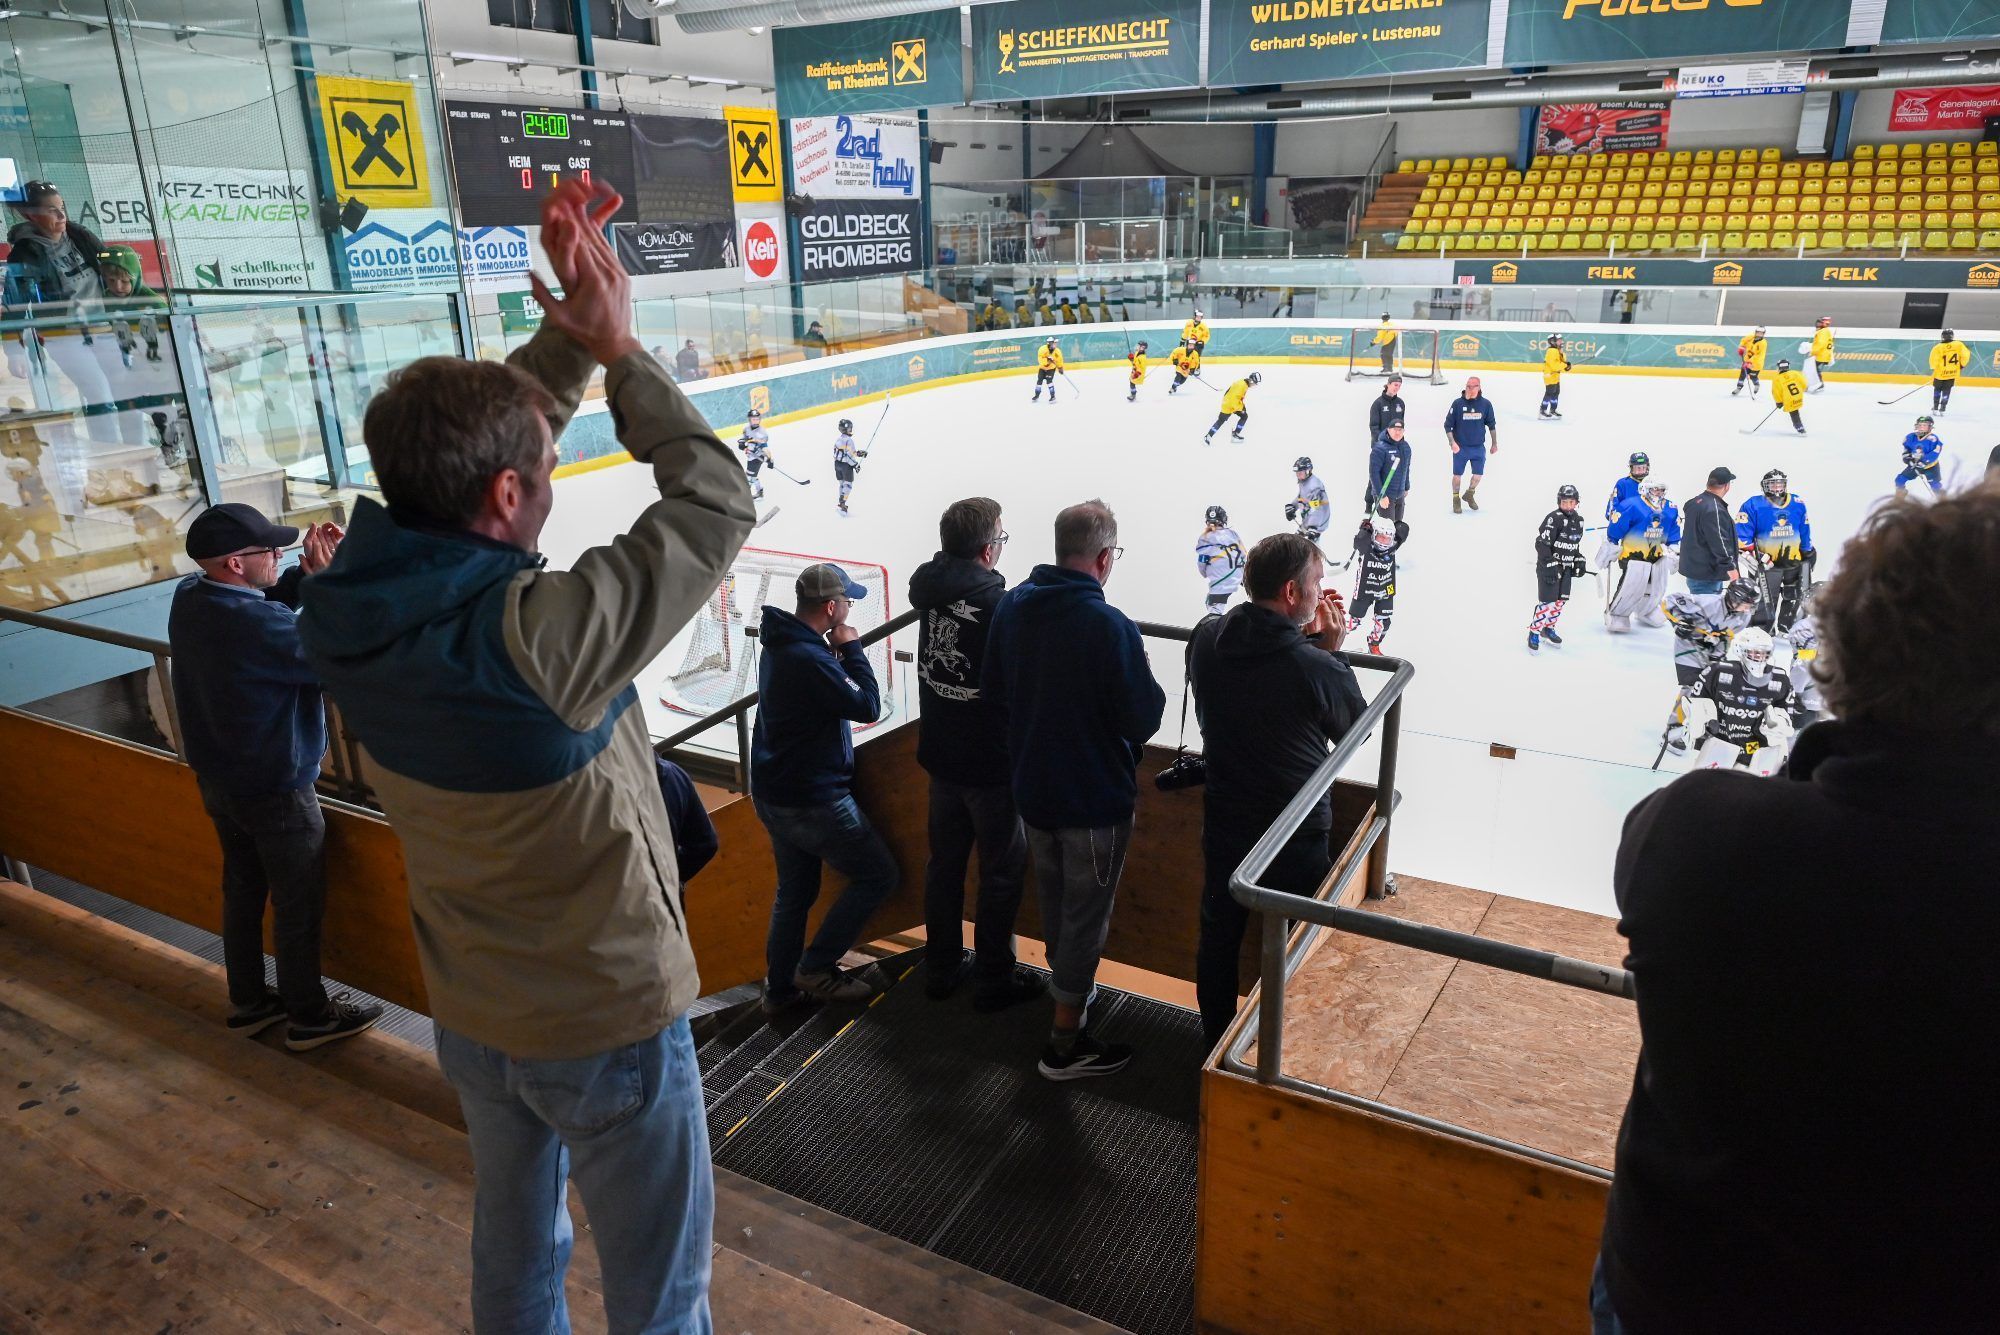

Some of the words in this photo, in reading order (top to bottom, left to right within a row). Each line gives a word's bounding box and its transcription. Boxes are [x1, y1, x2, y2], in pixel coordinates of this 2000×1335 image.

[1018, 19, 1170, 50] SCHEFFKNECHT
[1250, 34, 1305, 51] Gerhard
[1309, 31, 1358, 49] Spieler
[1372, 25, 1441, 42] Lustenau
[1018, 57, 1062, 67] KRANARBEITEN
[1067, 53, 1123, 64] MONTAGETECHNIK
[1129, 49, 1169, 59] TRANSPORTE
[806, 57, 888, 77] Raiffeisenbank
[844, 71, 889, 89] Rheintal
[1681, 75, 1725, 85] NEUKO
[1627, 100, 1646, 108] Alles
[1937, 111, 1964, 119] Martin
[1965, 109, 1981, 118] Fitz
[525, 114, 567, 137] 24:00
[508, 155, 531, 168] HEIM
[568, 157, 590, 169] GAST
[521, 168, 532, 189] 0
[157, 182, 306, 200] KFZ-TECHNIK
[162, 203, 310, 222] KARLINGER
[801, 214, 911, 239] GOLDBECK
[349, 247, 412, 267] GOLOB
[475, 242, 528, 260] GOLOB
[803, 242, 912, 270] RHOMBERG
[477, 259, 530, 271] IMMODREAMS
[1601, 266, 1636, 279] ELK
[1713, 269, 1742, 277] GOLOB
[1838, 267, 1880, 281] ELK
[1968, 271, 2000, 279] GOLOB
[233, 275, 302, 289] transporte
[1290, 335, 1343, 345] GUNZ
[1942, 353, 1959, 367] 14
[1787, 383, 1800, 396] 6
